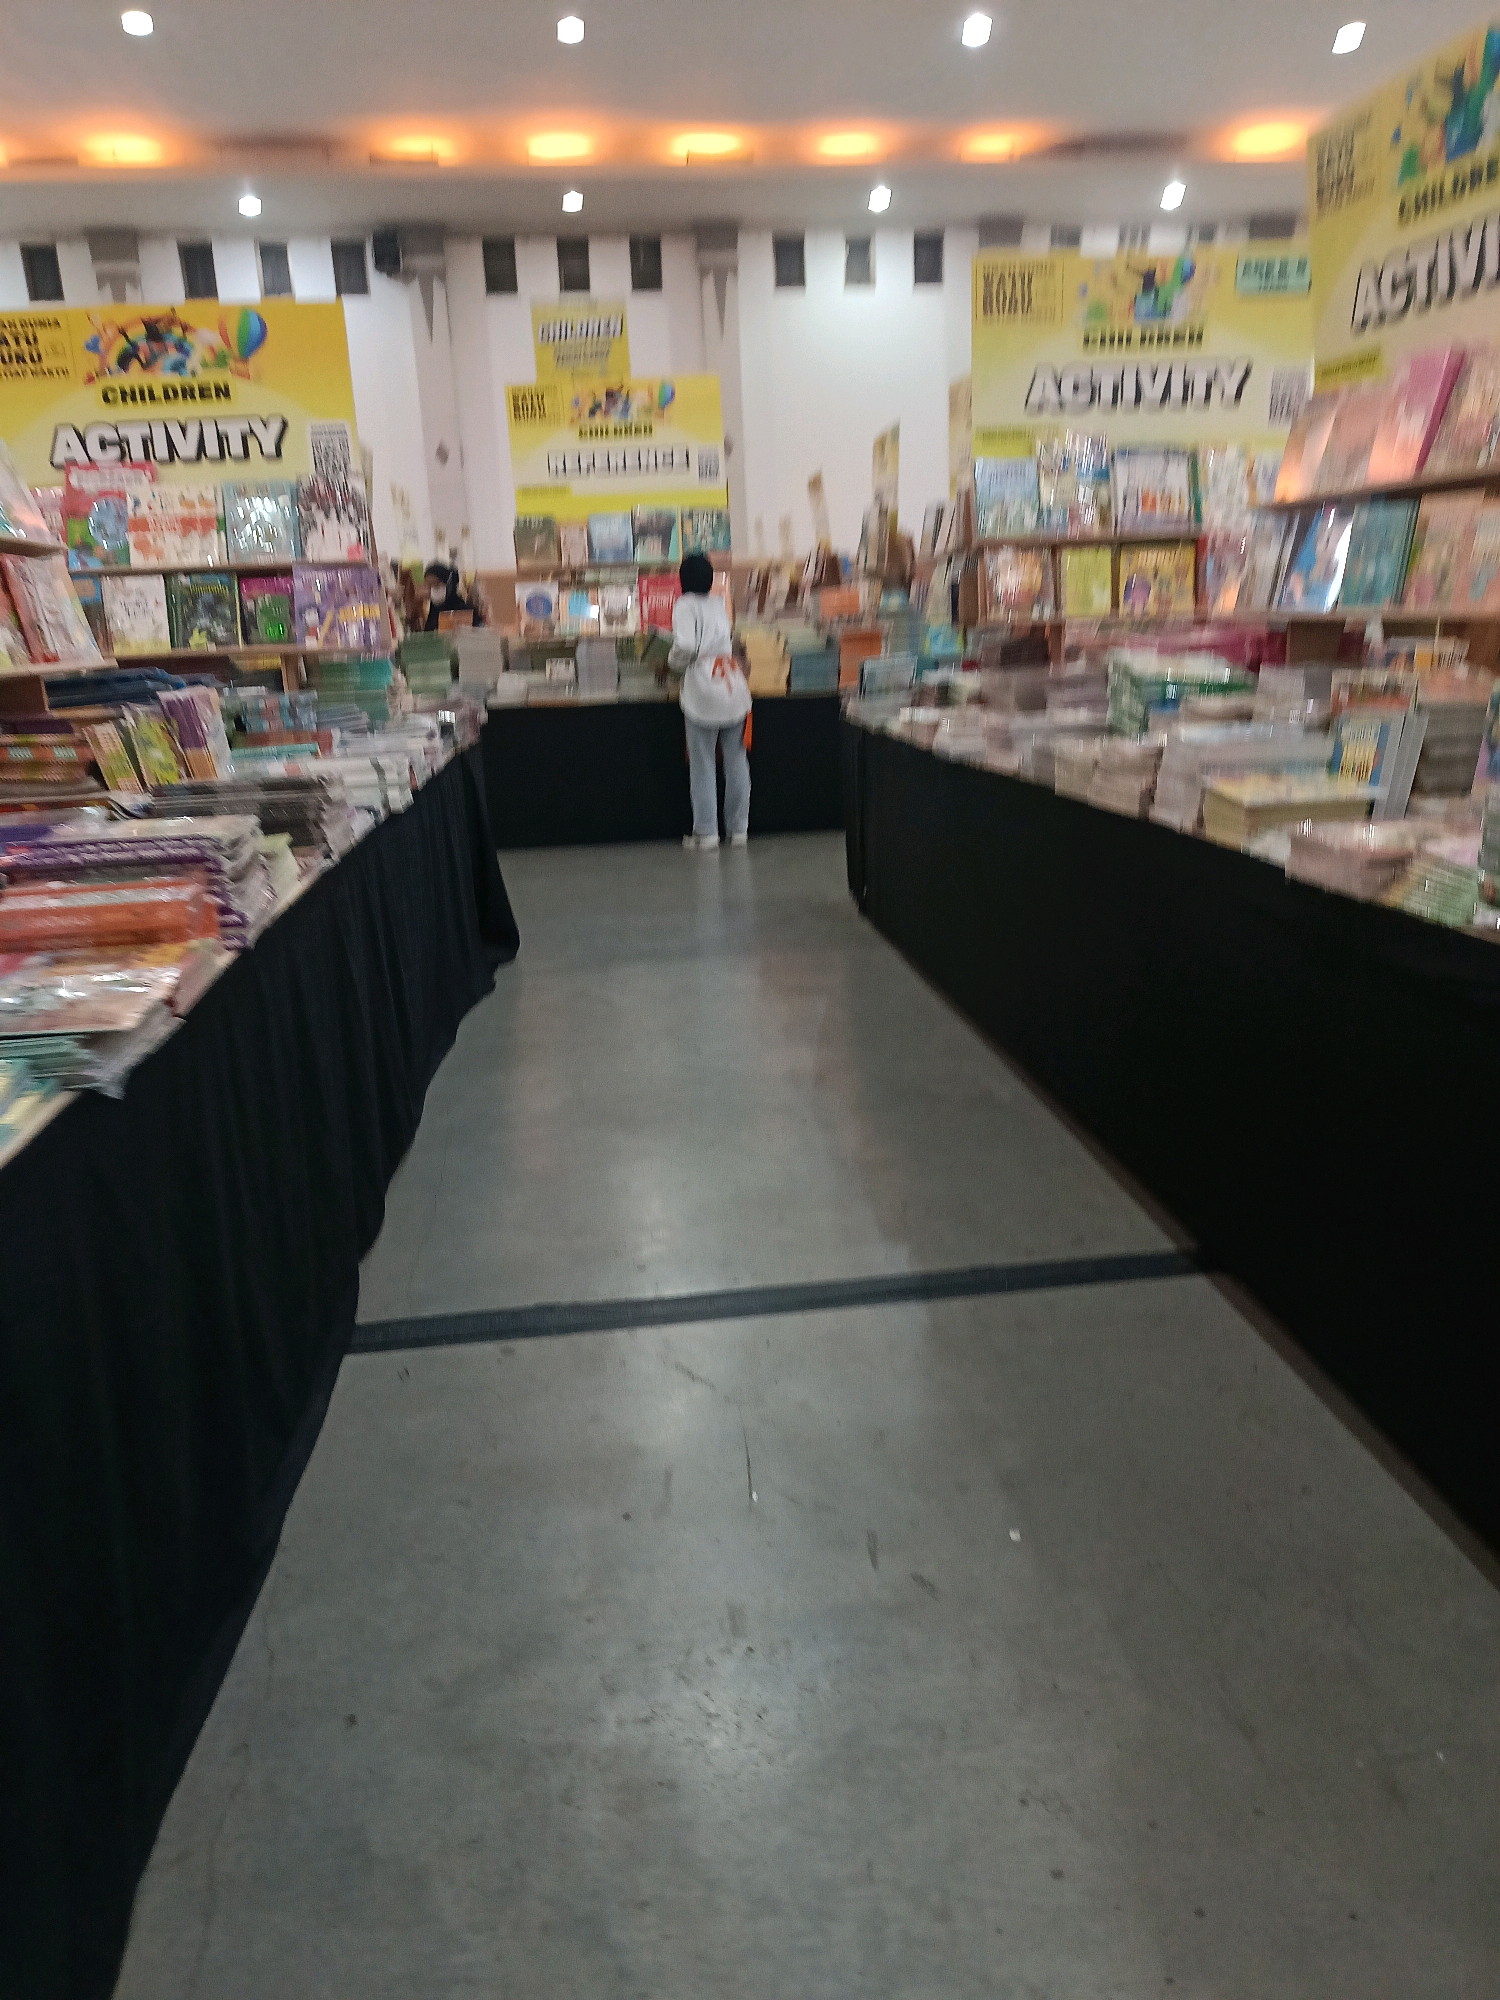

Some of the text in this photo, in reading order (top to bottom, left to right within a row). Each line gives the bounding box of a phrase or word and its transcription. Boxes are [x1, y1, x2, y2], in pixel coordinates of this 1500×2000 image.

[1398, 153, 1500, 226] CHILDRE
[1350, 208, 1500, 338] ACTIVI
[101, 381, 233, 406] CHILDREN
[1024, 357, 1253, 416] ACTIVITY
[50, 414, 288, 469] ACTIVITY
